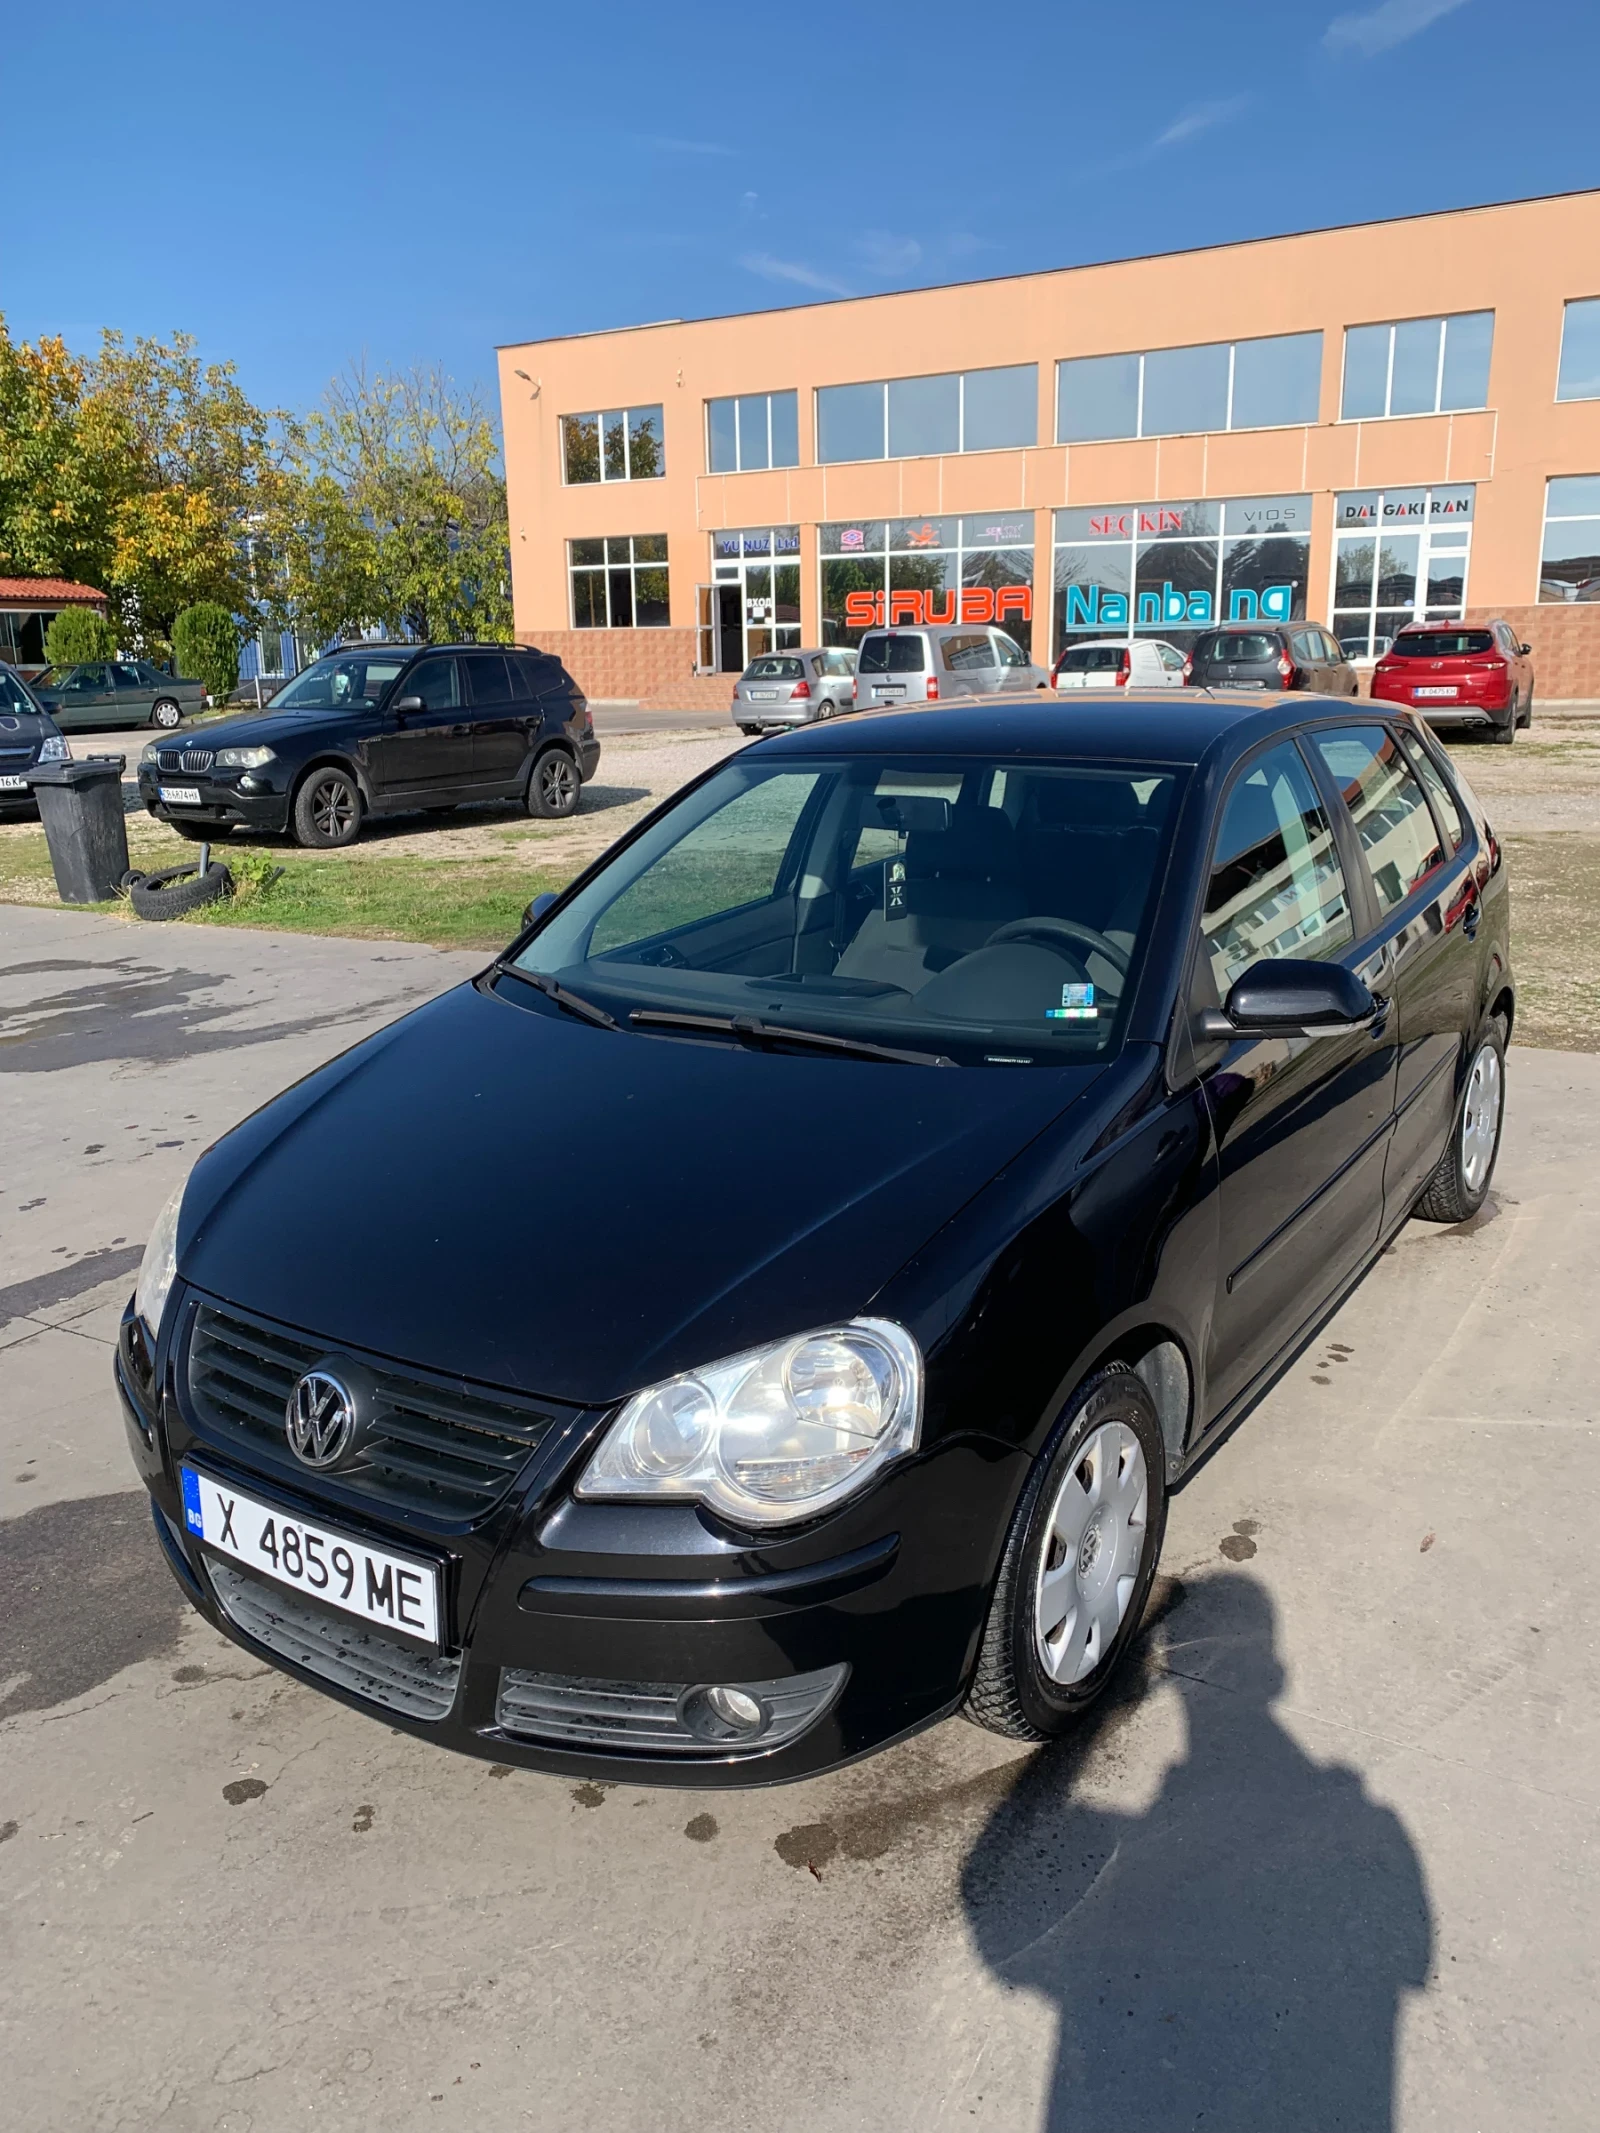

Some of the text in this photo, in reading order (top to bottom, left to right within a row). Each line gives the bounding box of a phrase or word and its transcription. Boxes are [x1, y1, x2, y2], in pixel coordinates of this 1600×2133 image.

[1244, 508, 1296, 521] VIOS
[1345, 499, 1469, 518] DALGAKIRAN
[1089, 507, 1184, 538] SEÇKİN
[722, 535, 798, 553] YUNUZ Ltd
[747, 598, 772, 608] ВХОД
[846, 585, 1032, 627] SiRUBA
[1066, 581, 1293, 624] Nanbang
[187, 1508, 202, 1528] BG
[216, 1492, 425, 1630] X 4859 ME
